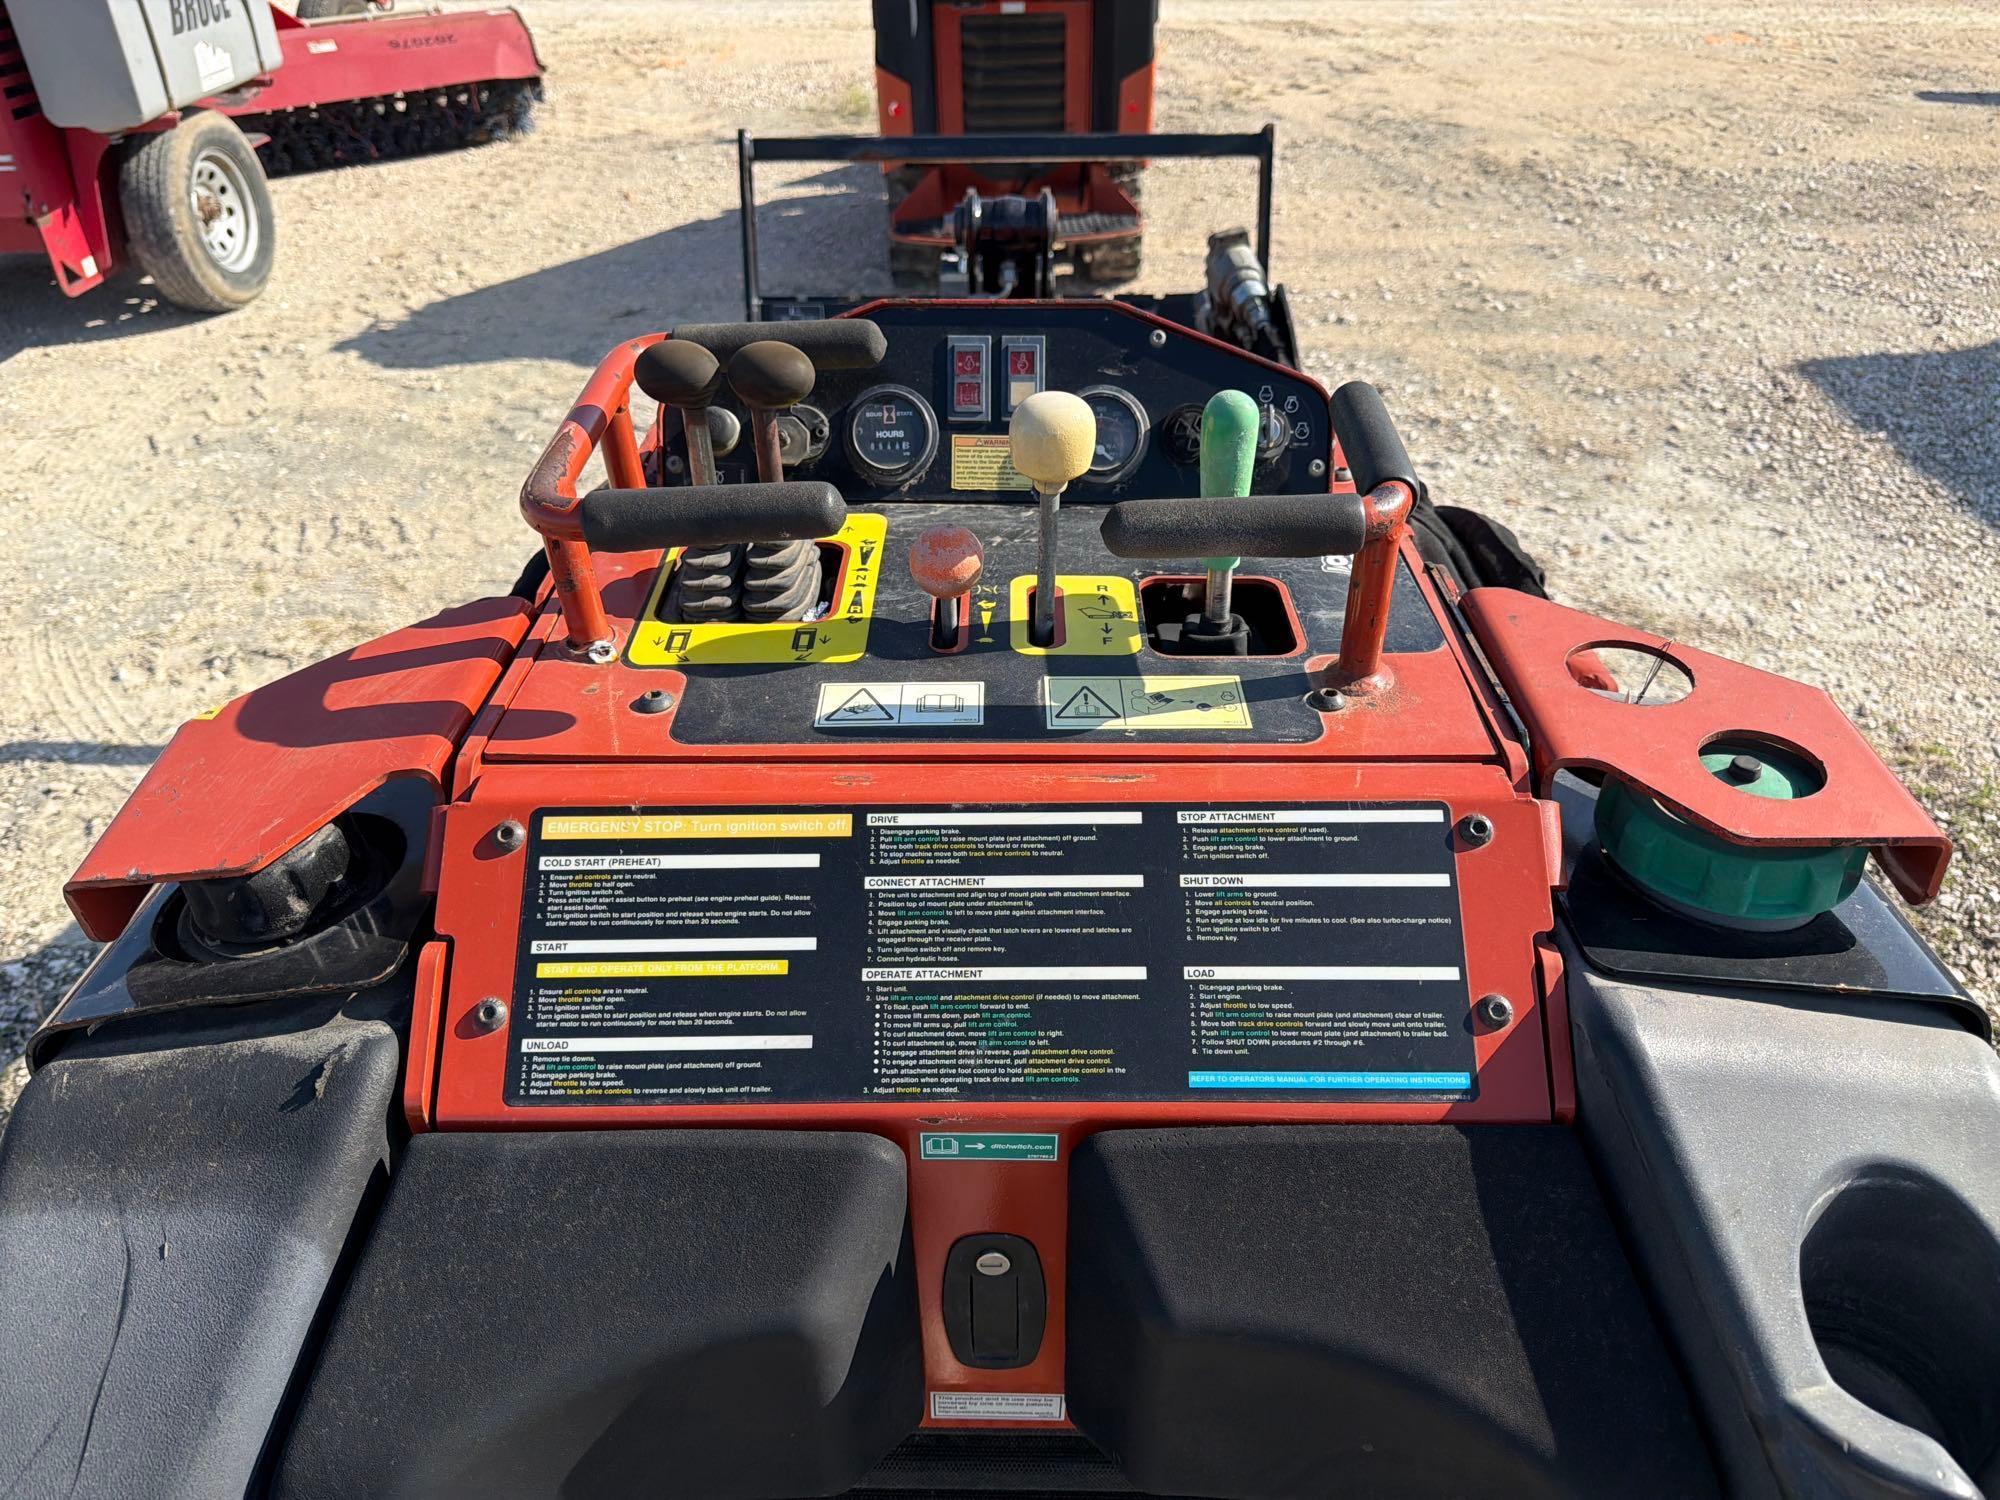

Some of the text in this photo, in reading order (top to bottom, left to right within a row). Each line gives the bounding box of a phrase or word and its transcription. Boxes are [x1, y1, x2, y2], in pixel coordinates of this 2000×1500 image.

[876, 430, 904, 438] HOURS
[870, 816, 898, 824] DRIVE
[1181, 812, 1275, 821] STOP ATTACHMENT
[546, 819, 848, 835] EMERGENCY STOP: Turn ignition switch off.
[1308, 827, 1329, 835] used).
[989, 835, 1005, 843] plate
[1072, 834, 1097, 843] ground.
[544, 857, 661, 869] COLD START (PREHEAT)
[869, 878, 985, 887] CONNECT ATTACHMENT
[1183, 876, 1243, 885] SHUT DOWN
[565, 889, 590, 897] ignition
[667, 896, 693, 904] preheat
[710, 895, 733, 903] engine
[734, 895, 759, 903] preheat
[760, 895, 783, 903] guide).
[1286, 899, 1314, 908] position.
[877, 936, 906, 944] engaged
[907, 936, 933, 944] through
[974, 936, 992, 944] plate.
[536, 942, 567, 952] START
[906, 955, 936, 964] hydraulic
[544, 962, 778, 974] START AND OPERATE ONLY FROM THE PLATFORM.
[866, 969, 982, 979] OPERATE ATTACHMENT
[1187, 969, 1215, 978] LOAD
[946, 1030, 966, 1039] down,
[1046, 1030, 1063, 1038] right.
[526, 1041, 569, 1050] UNLOAD
[1272, 1039, 1311, 1048] procedures
[1324, 1039, 1351, 1048] through
[531, 1072, 567, 1080] Disengage
[568, 1072, 594, 1080] parking
